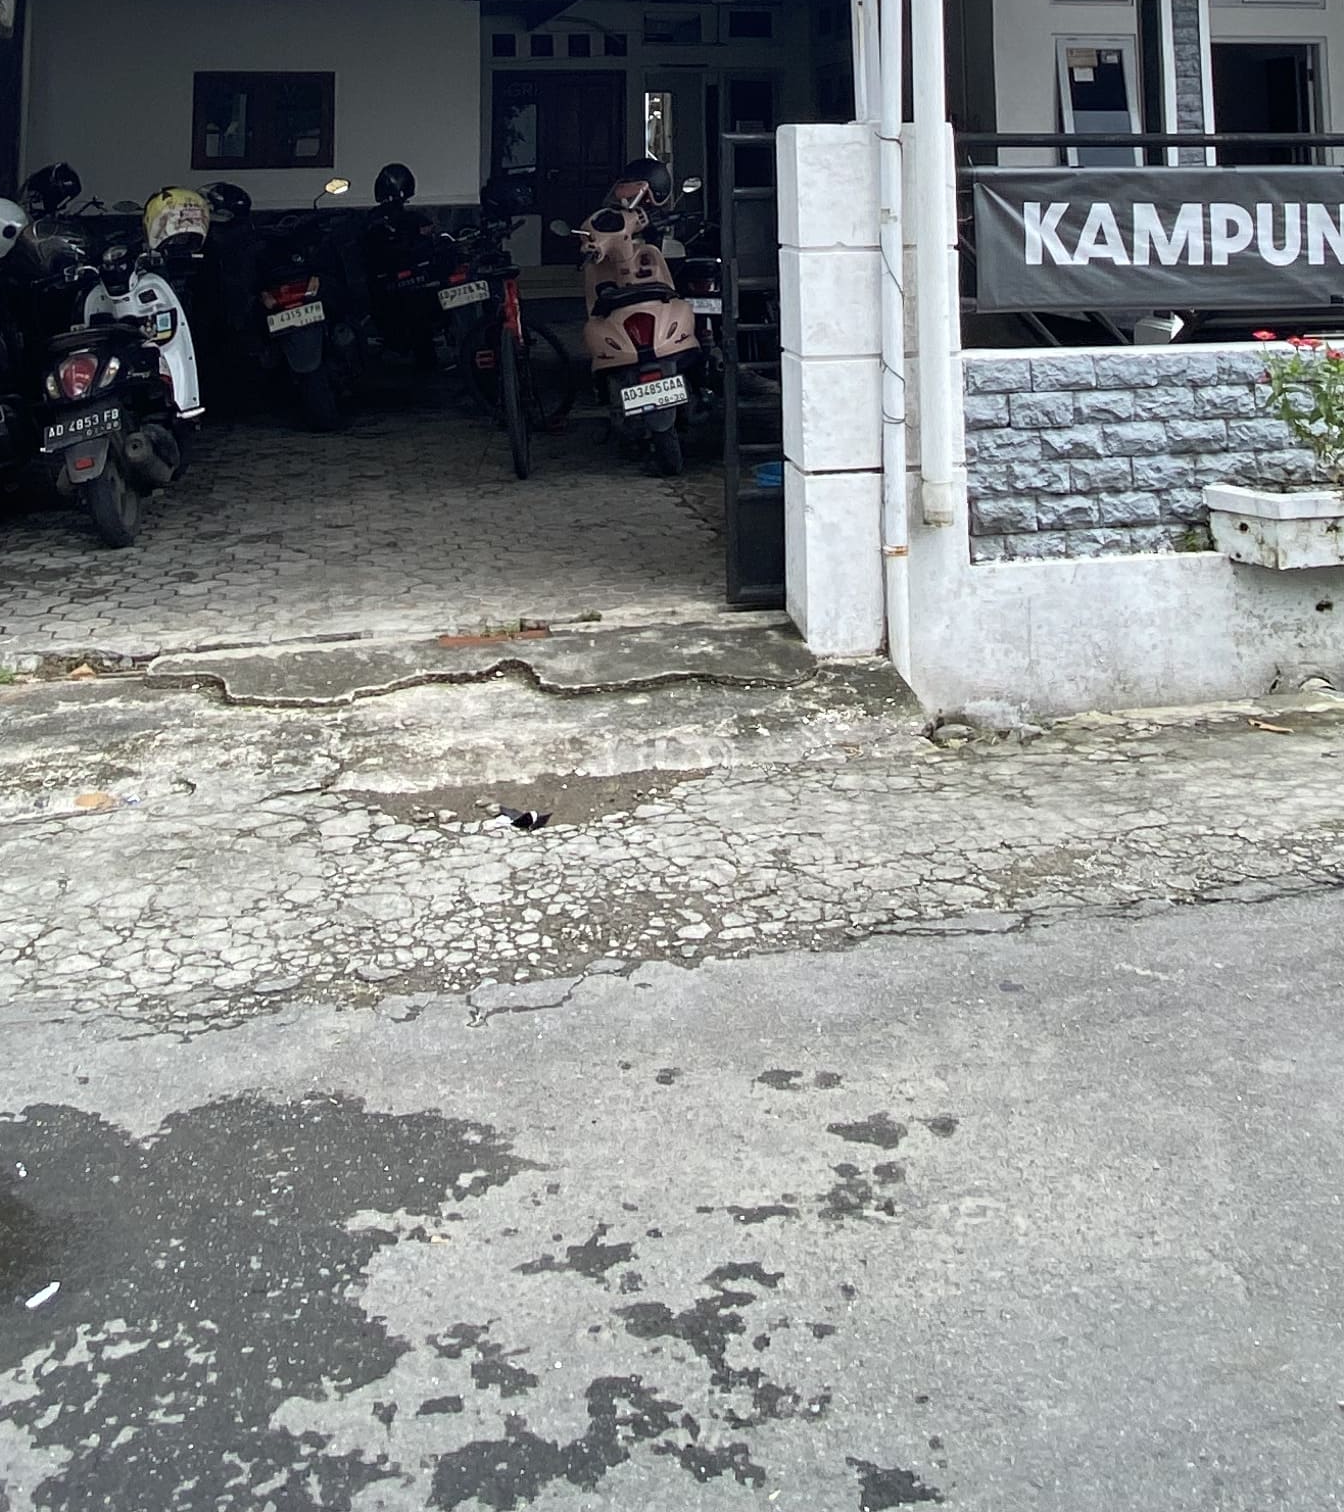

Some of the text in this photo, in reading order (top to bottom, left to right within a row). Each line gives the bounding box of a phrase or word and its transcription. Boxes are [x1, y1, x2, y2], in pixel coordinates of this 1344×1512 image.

[623, 388, 637, 402] AD
[48, 424, 64, 438] AD
[68, 414, 99, 432] 4853
